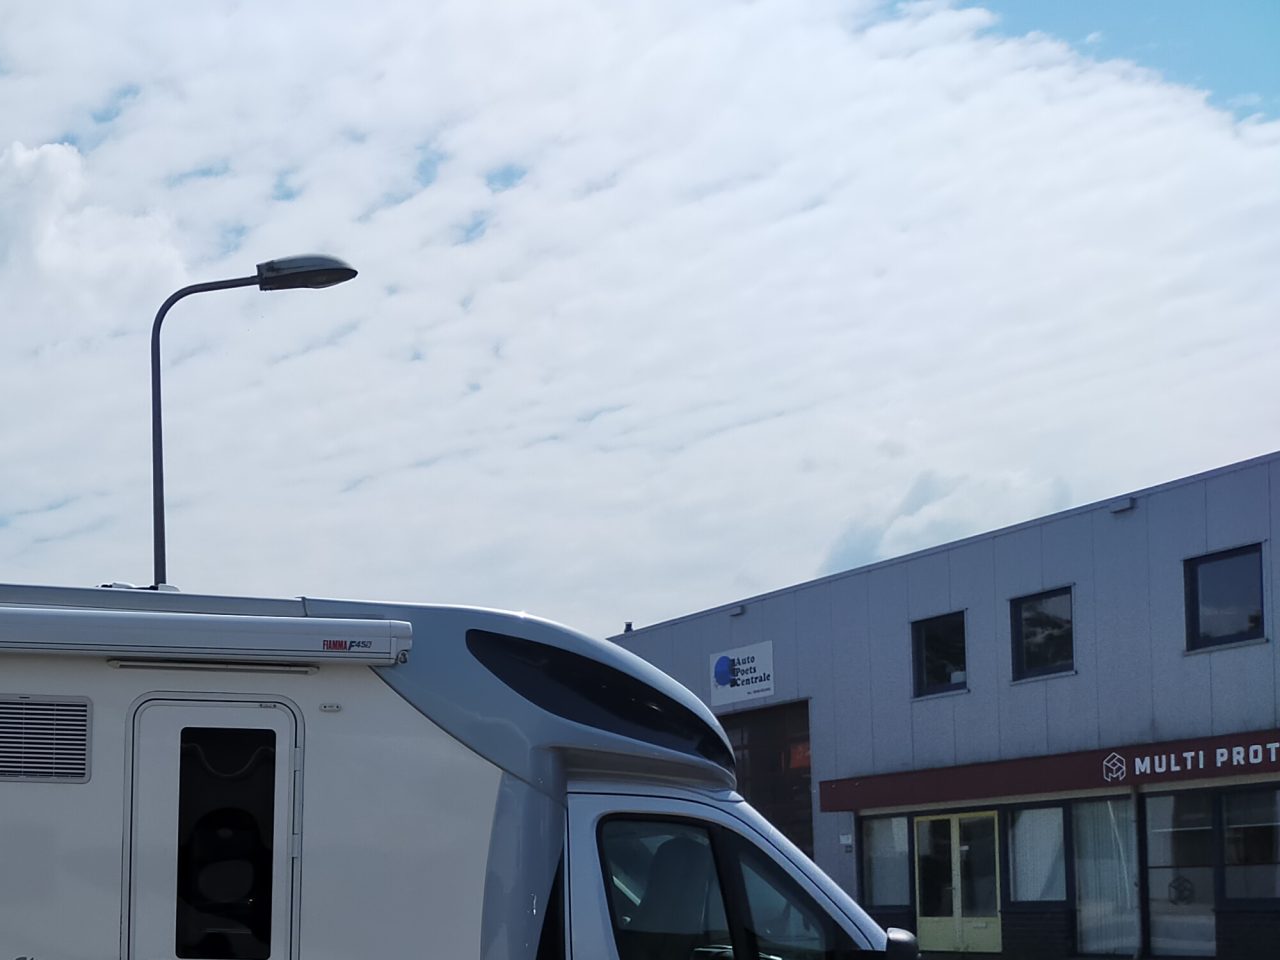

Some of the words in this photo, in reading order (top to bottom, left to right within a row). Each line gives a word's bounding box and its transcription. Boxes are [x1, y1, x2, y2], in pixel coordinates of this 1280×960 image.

[734, 655, 755, 667] Auto
[734, 672, 771, 687] Centrale
[1135, 750, 1204, 775] MULTI
[1216, 742, 1280, 767] PROT
